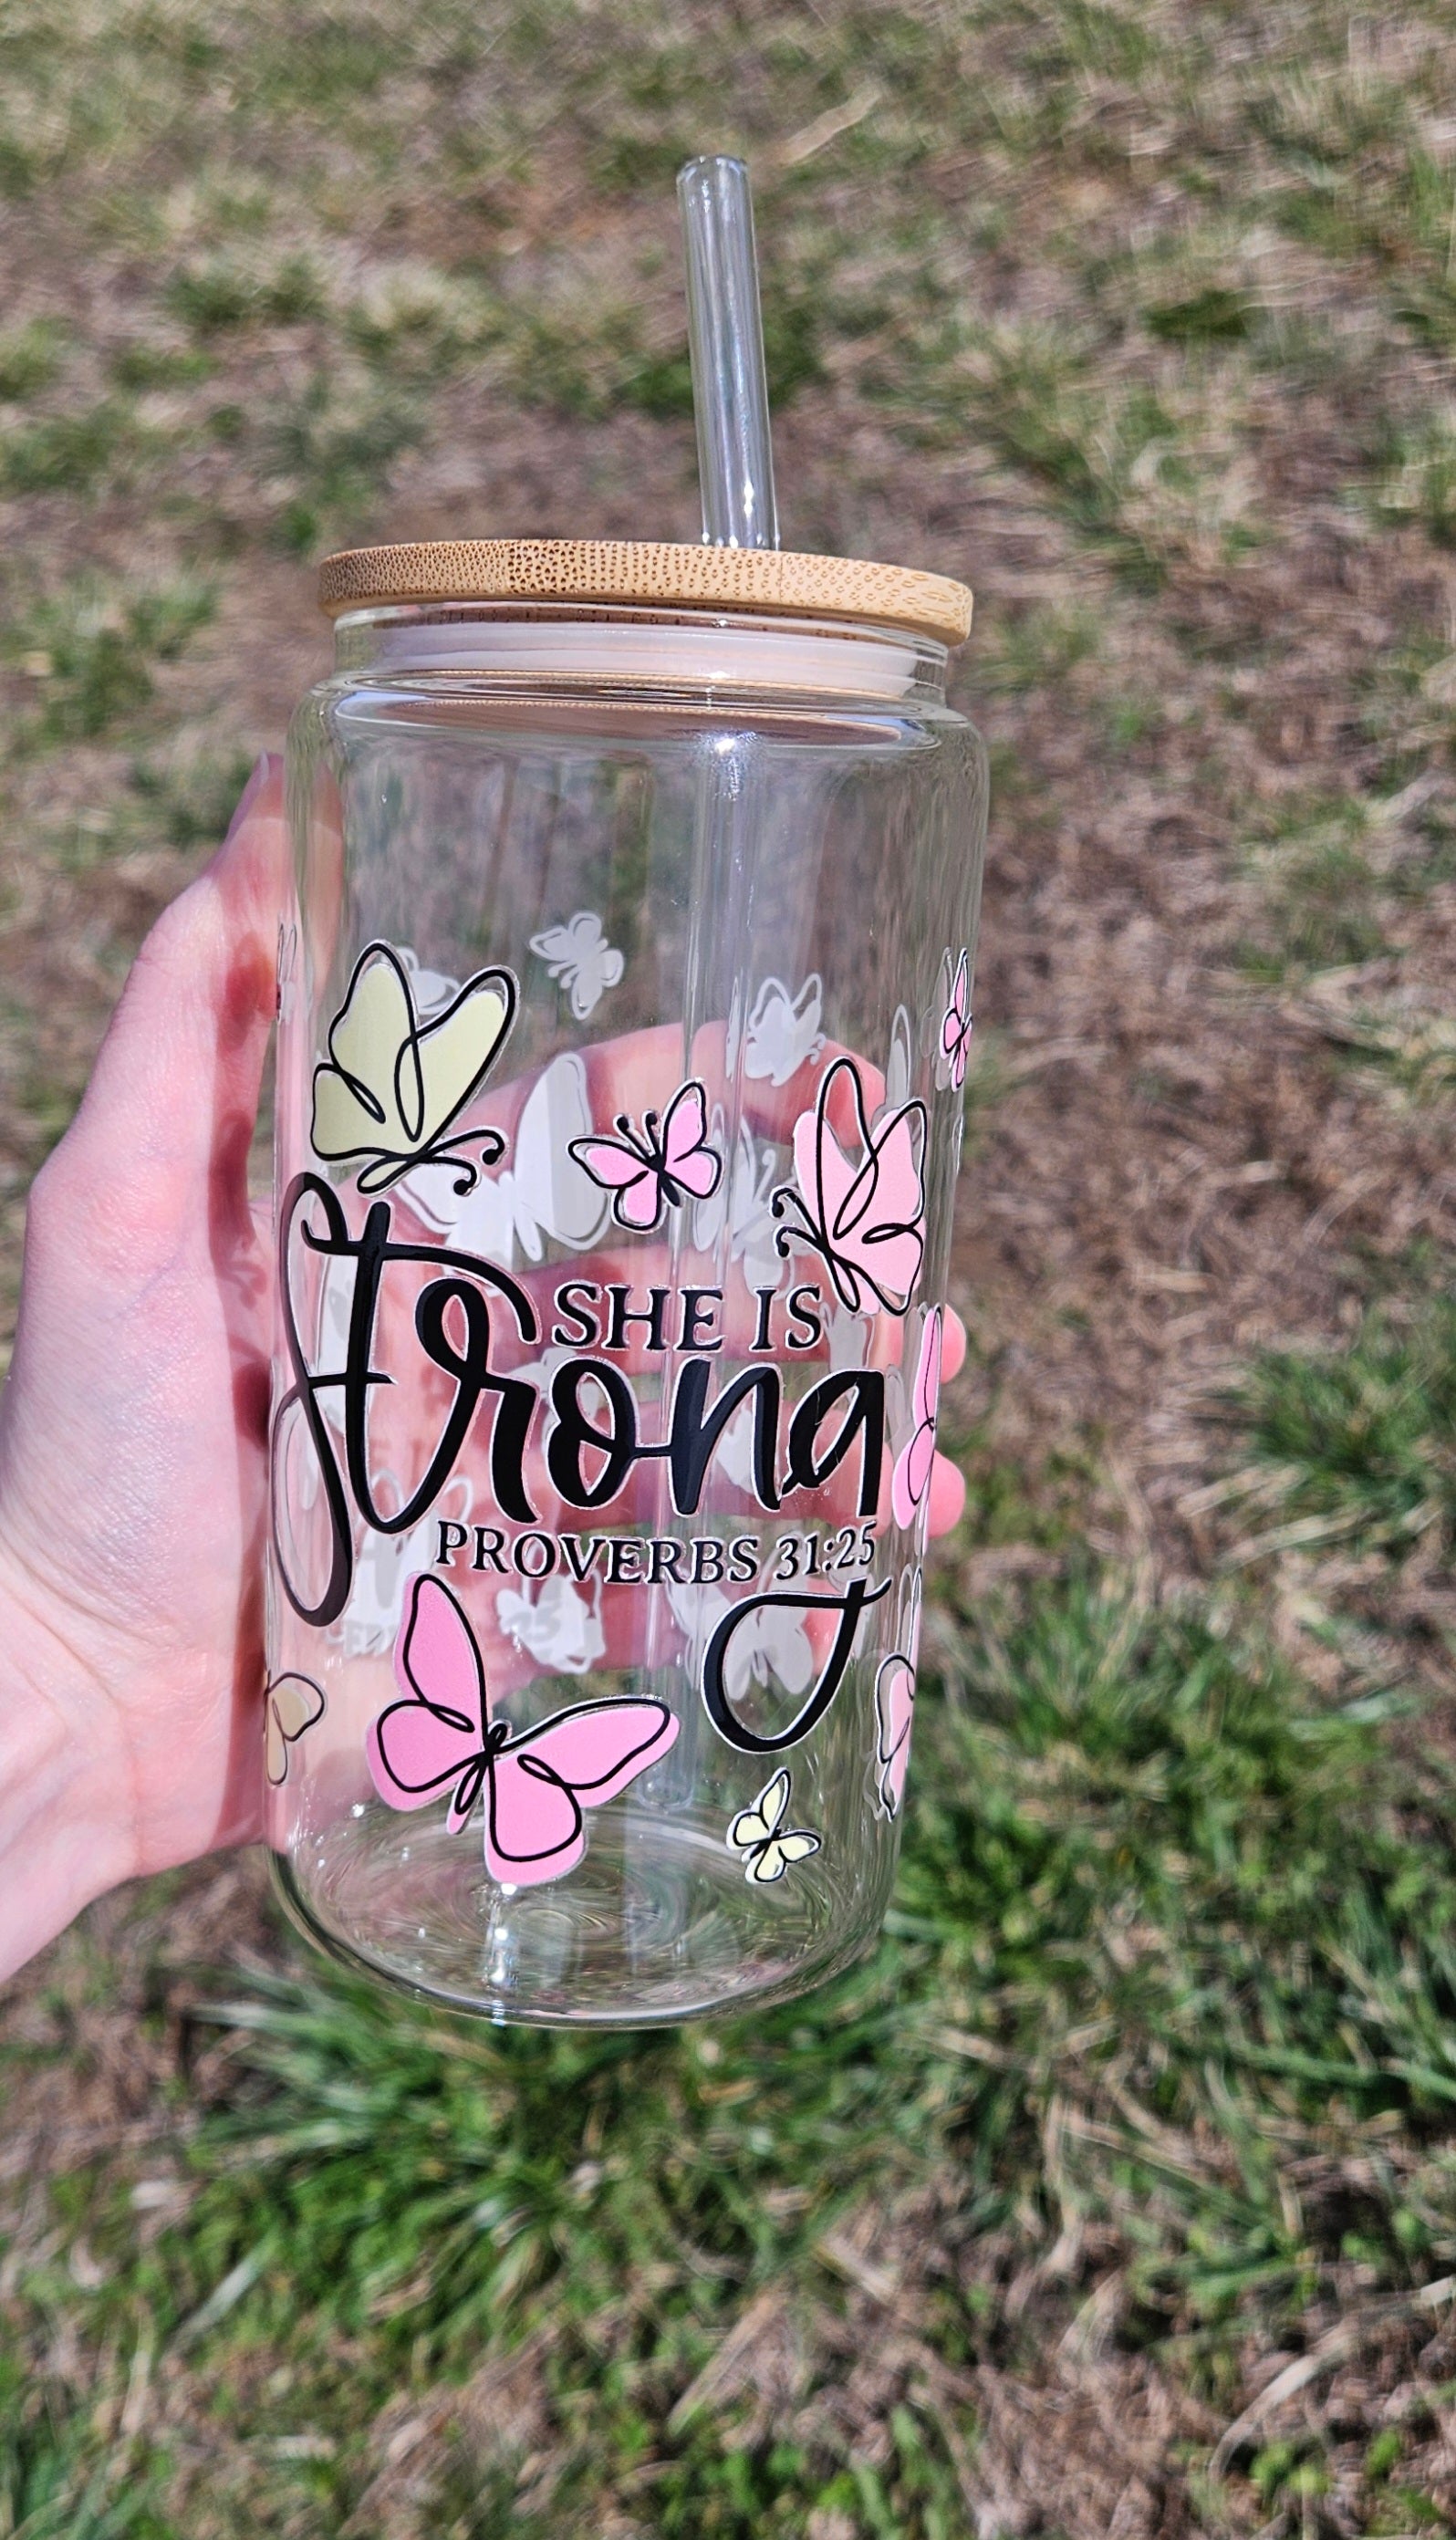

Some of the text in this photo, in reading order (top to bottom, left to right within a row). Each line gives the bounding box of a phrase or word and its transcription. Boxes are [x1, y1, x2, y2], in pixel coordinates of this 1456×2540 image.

[553, 1283, 821, 1351] SHE IS
[436, 1520, 877, 1584] PROVERBS 31:25
